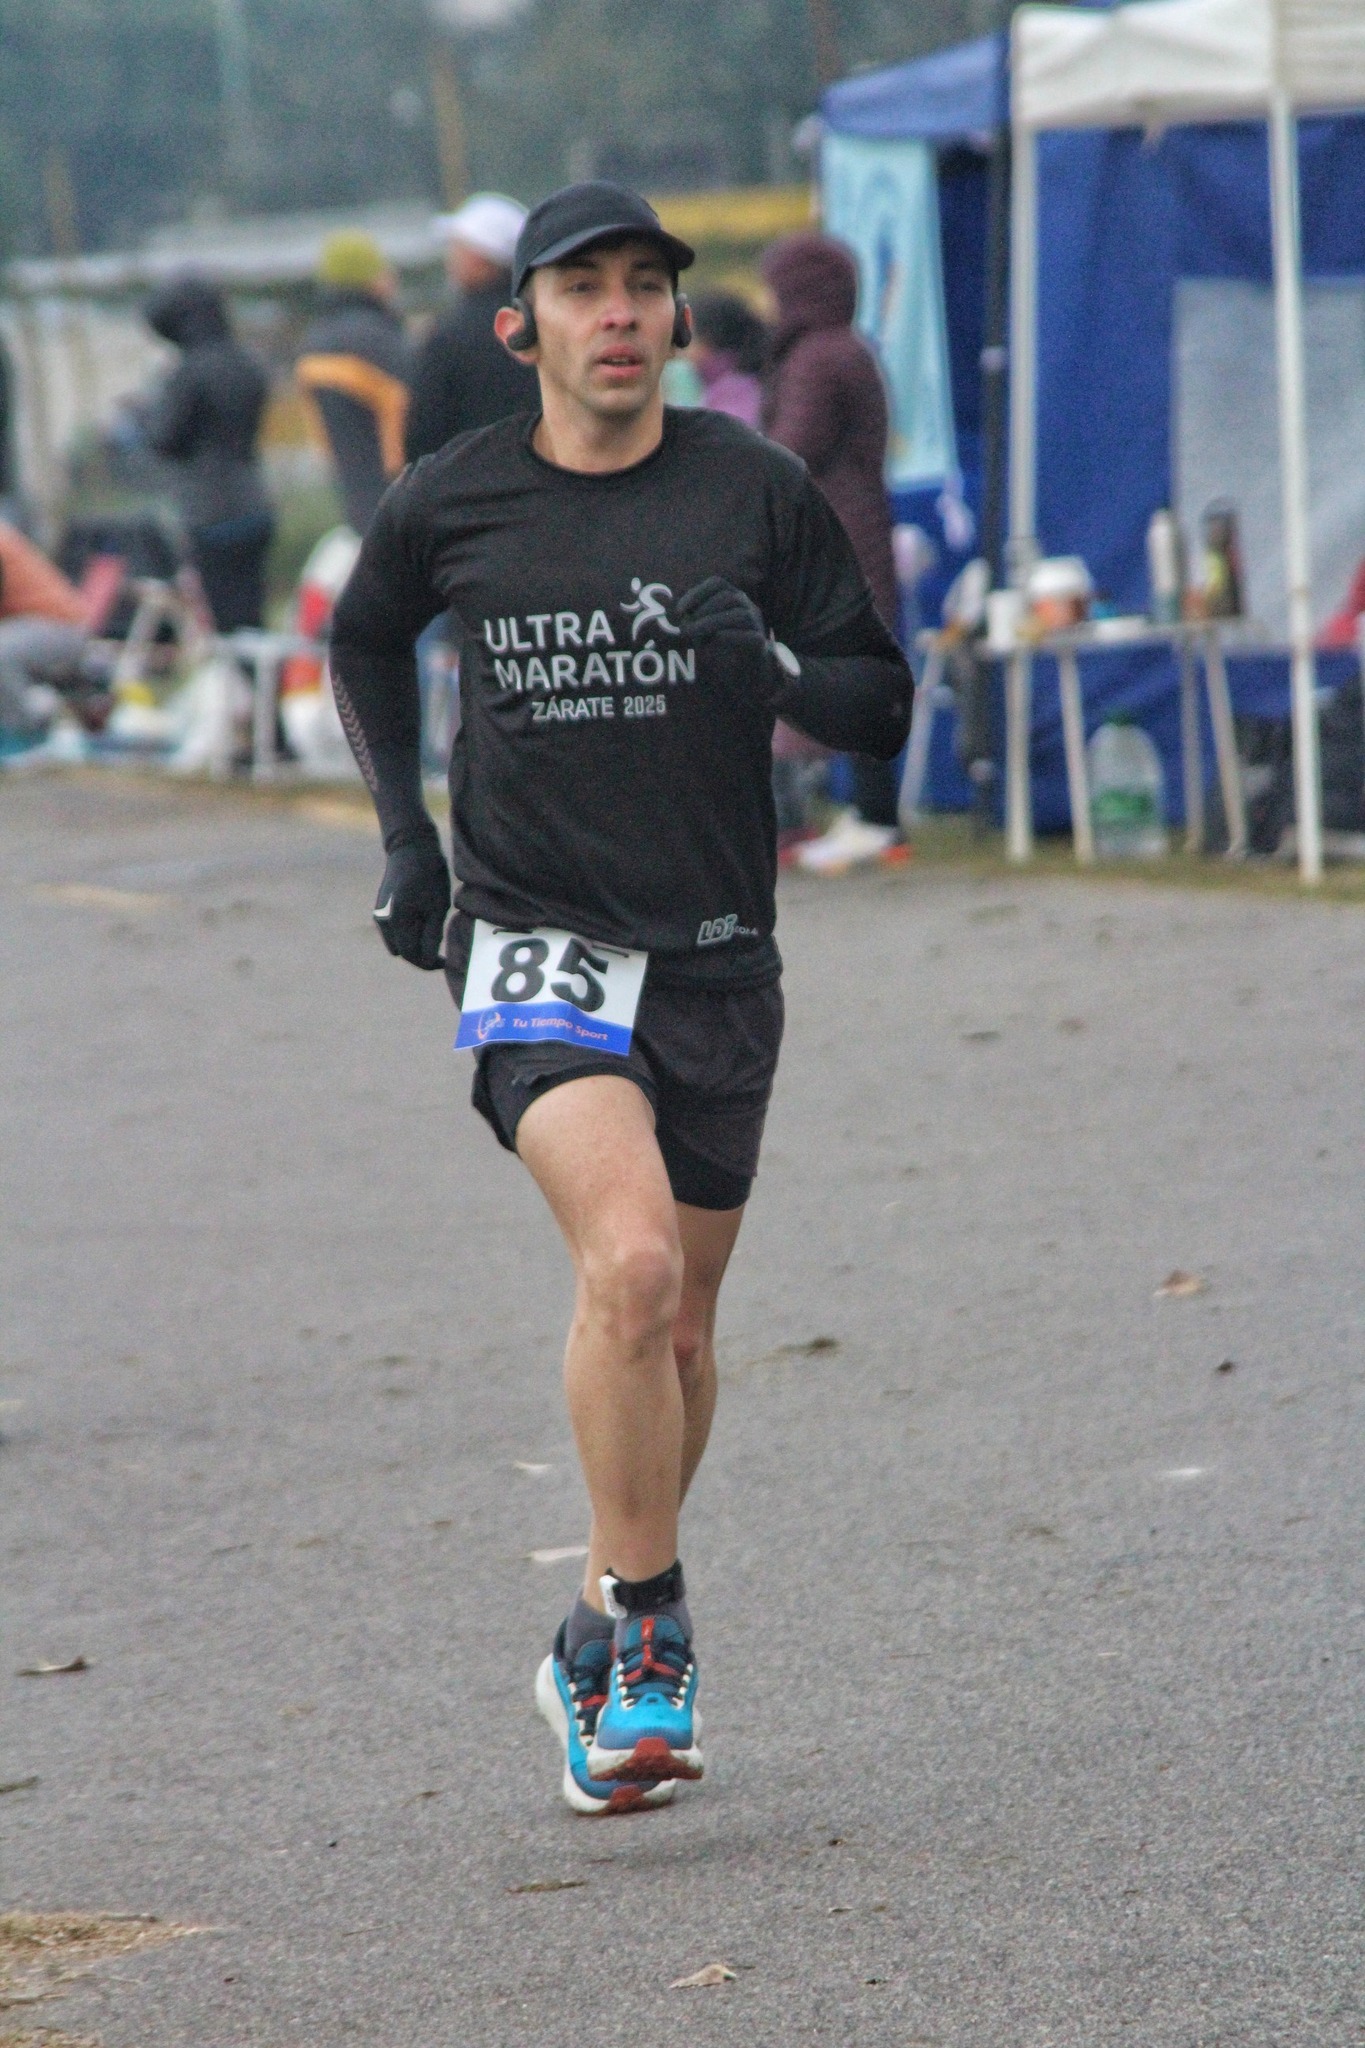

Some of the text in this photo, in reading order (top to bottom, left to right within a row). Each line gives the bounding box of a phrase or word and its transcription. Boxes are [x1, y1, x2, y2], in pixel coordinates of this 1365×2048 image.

[484, 609, 616, 652] ULTRA
[494, 639, 696, 692] MARATÓN
[531, 694, 667, 722] ZÁRATE 2025
[490, 937, 609, 1013] 85
[513, 1018, 528, 1028] Tu
[531, 1017, 574, 1029] Tiempo
[576, 1025, 608, 1041] Sport
